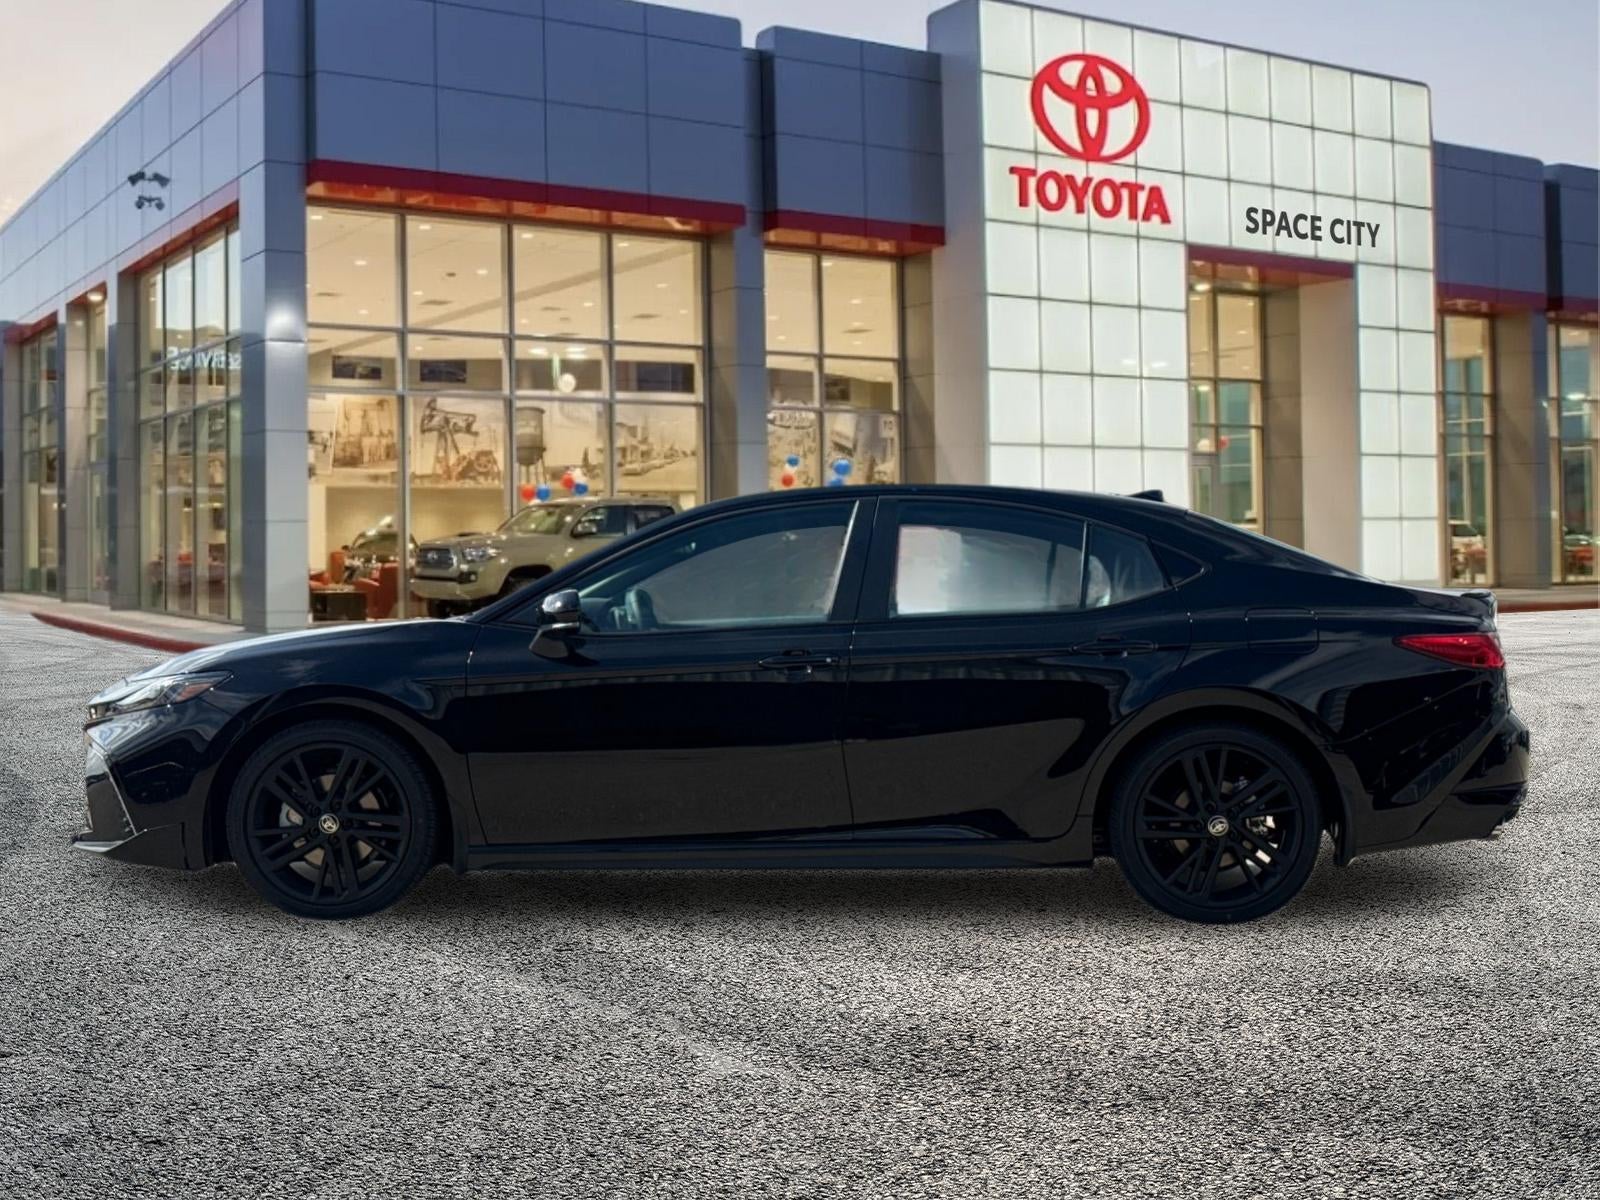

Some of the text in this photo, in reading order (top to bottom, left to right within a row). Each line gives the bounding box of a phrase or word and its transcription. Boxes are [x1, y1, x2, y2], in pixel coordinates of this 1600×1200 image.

[1009, 166, 1171, 225] TOYOTA
[1245, 206, 1381, 248] SPACE CITY
